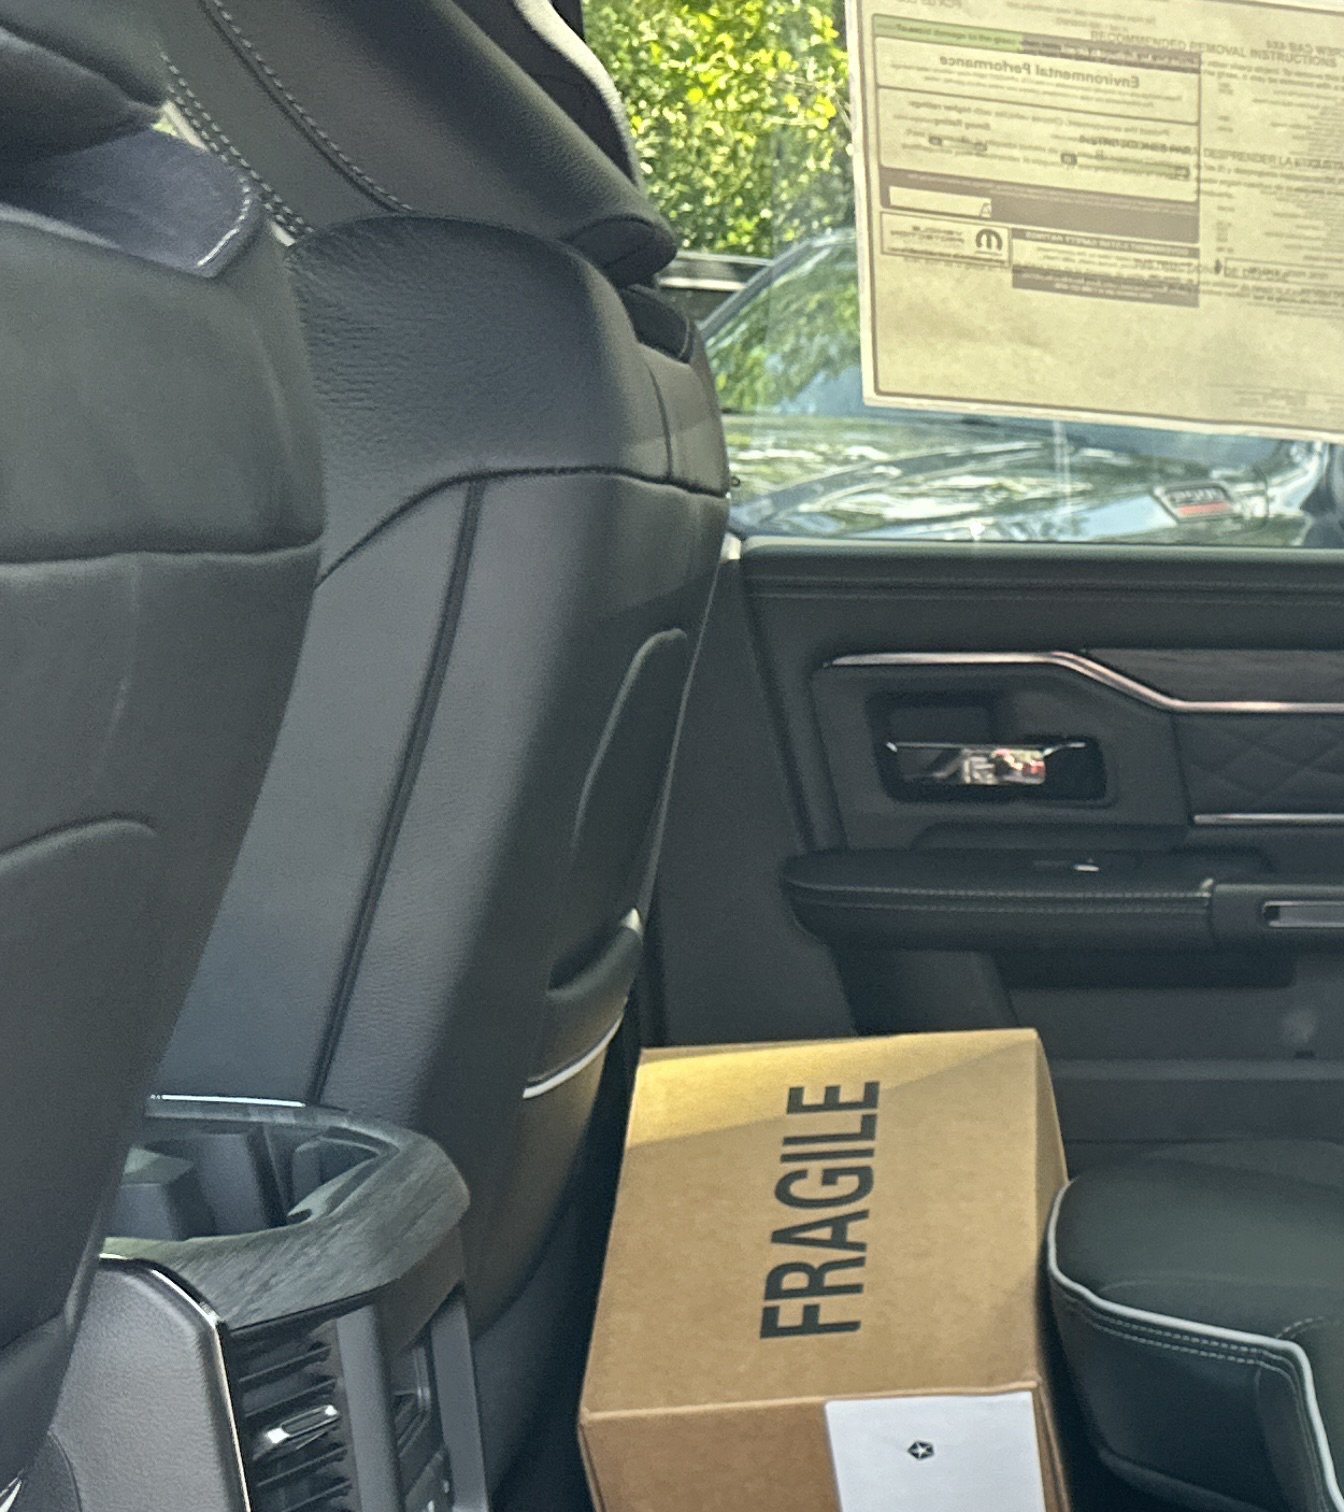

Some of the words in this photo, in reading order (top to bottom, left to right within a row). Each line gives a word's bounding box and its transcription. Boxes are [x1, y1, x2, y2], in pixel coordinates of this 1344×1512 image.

[1189, 41, 1246, 58] REMOVAL
[1250, 48, 1337, 67] INSTRUCTIONS
[760, 1080, 881, 1340] FRAGILE
